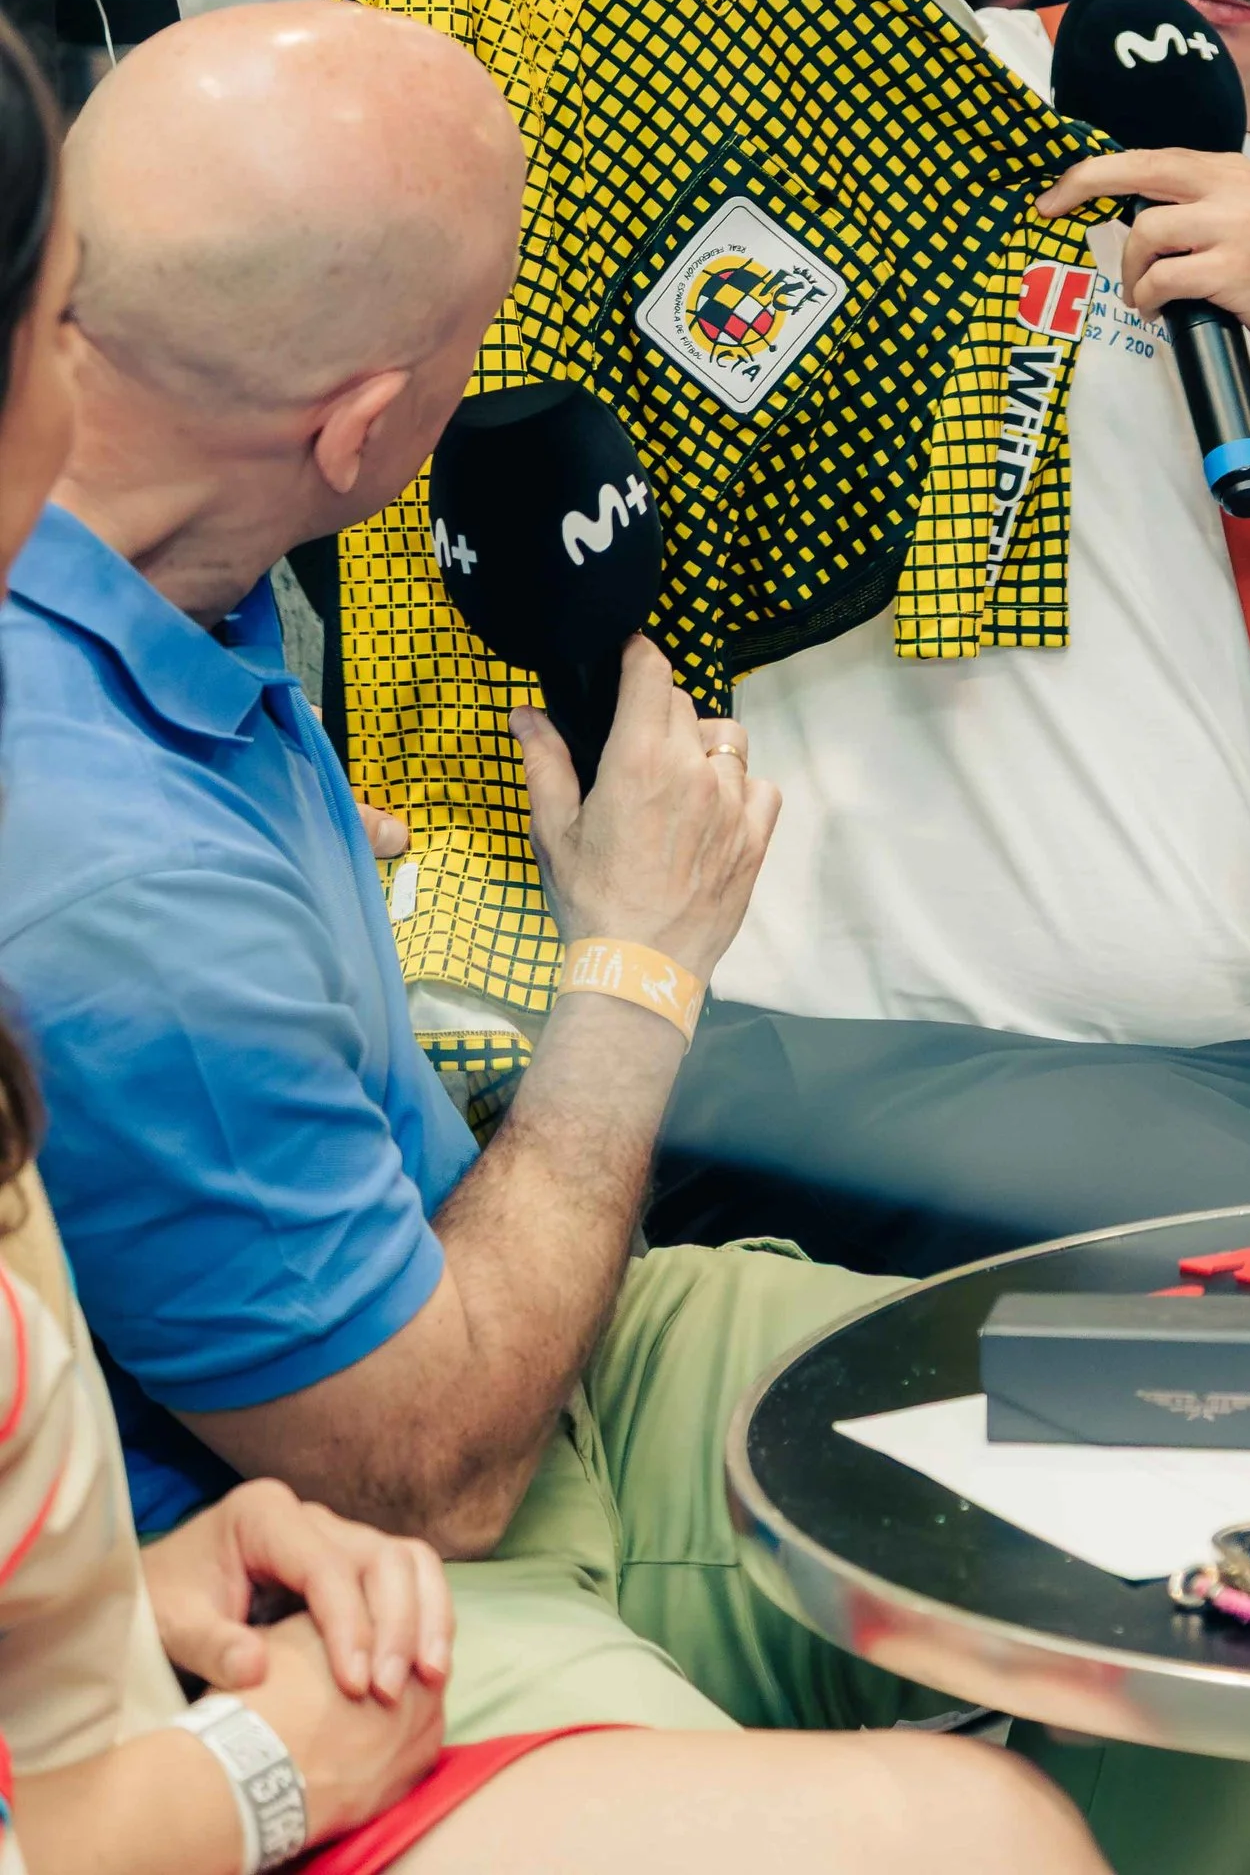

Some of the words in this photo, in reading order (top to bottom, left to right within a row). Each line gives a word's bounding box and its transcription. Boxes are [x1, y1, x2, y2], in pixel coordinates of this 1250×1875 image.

[728, 244, 746, 254] REAL
[675, 325, 685, 335] DE
[680, 336, 703, 360] FÚTBOL
[1125, 336, 1154, 359] 200
[716, 350, 761, 382] CTA
